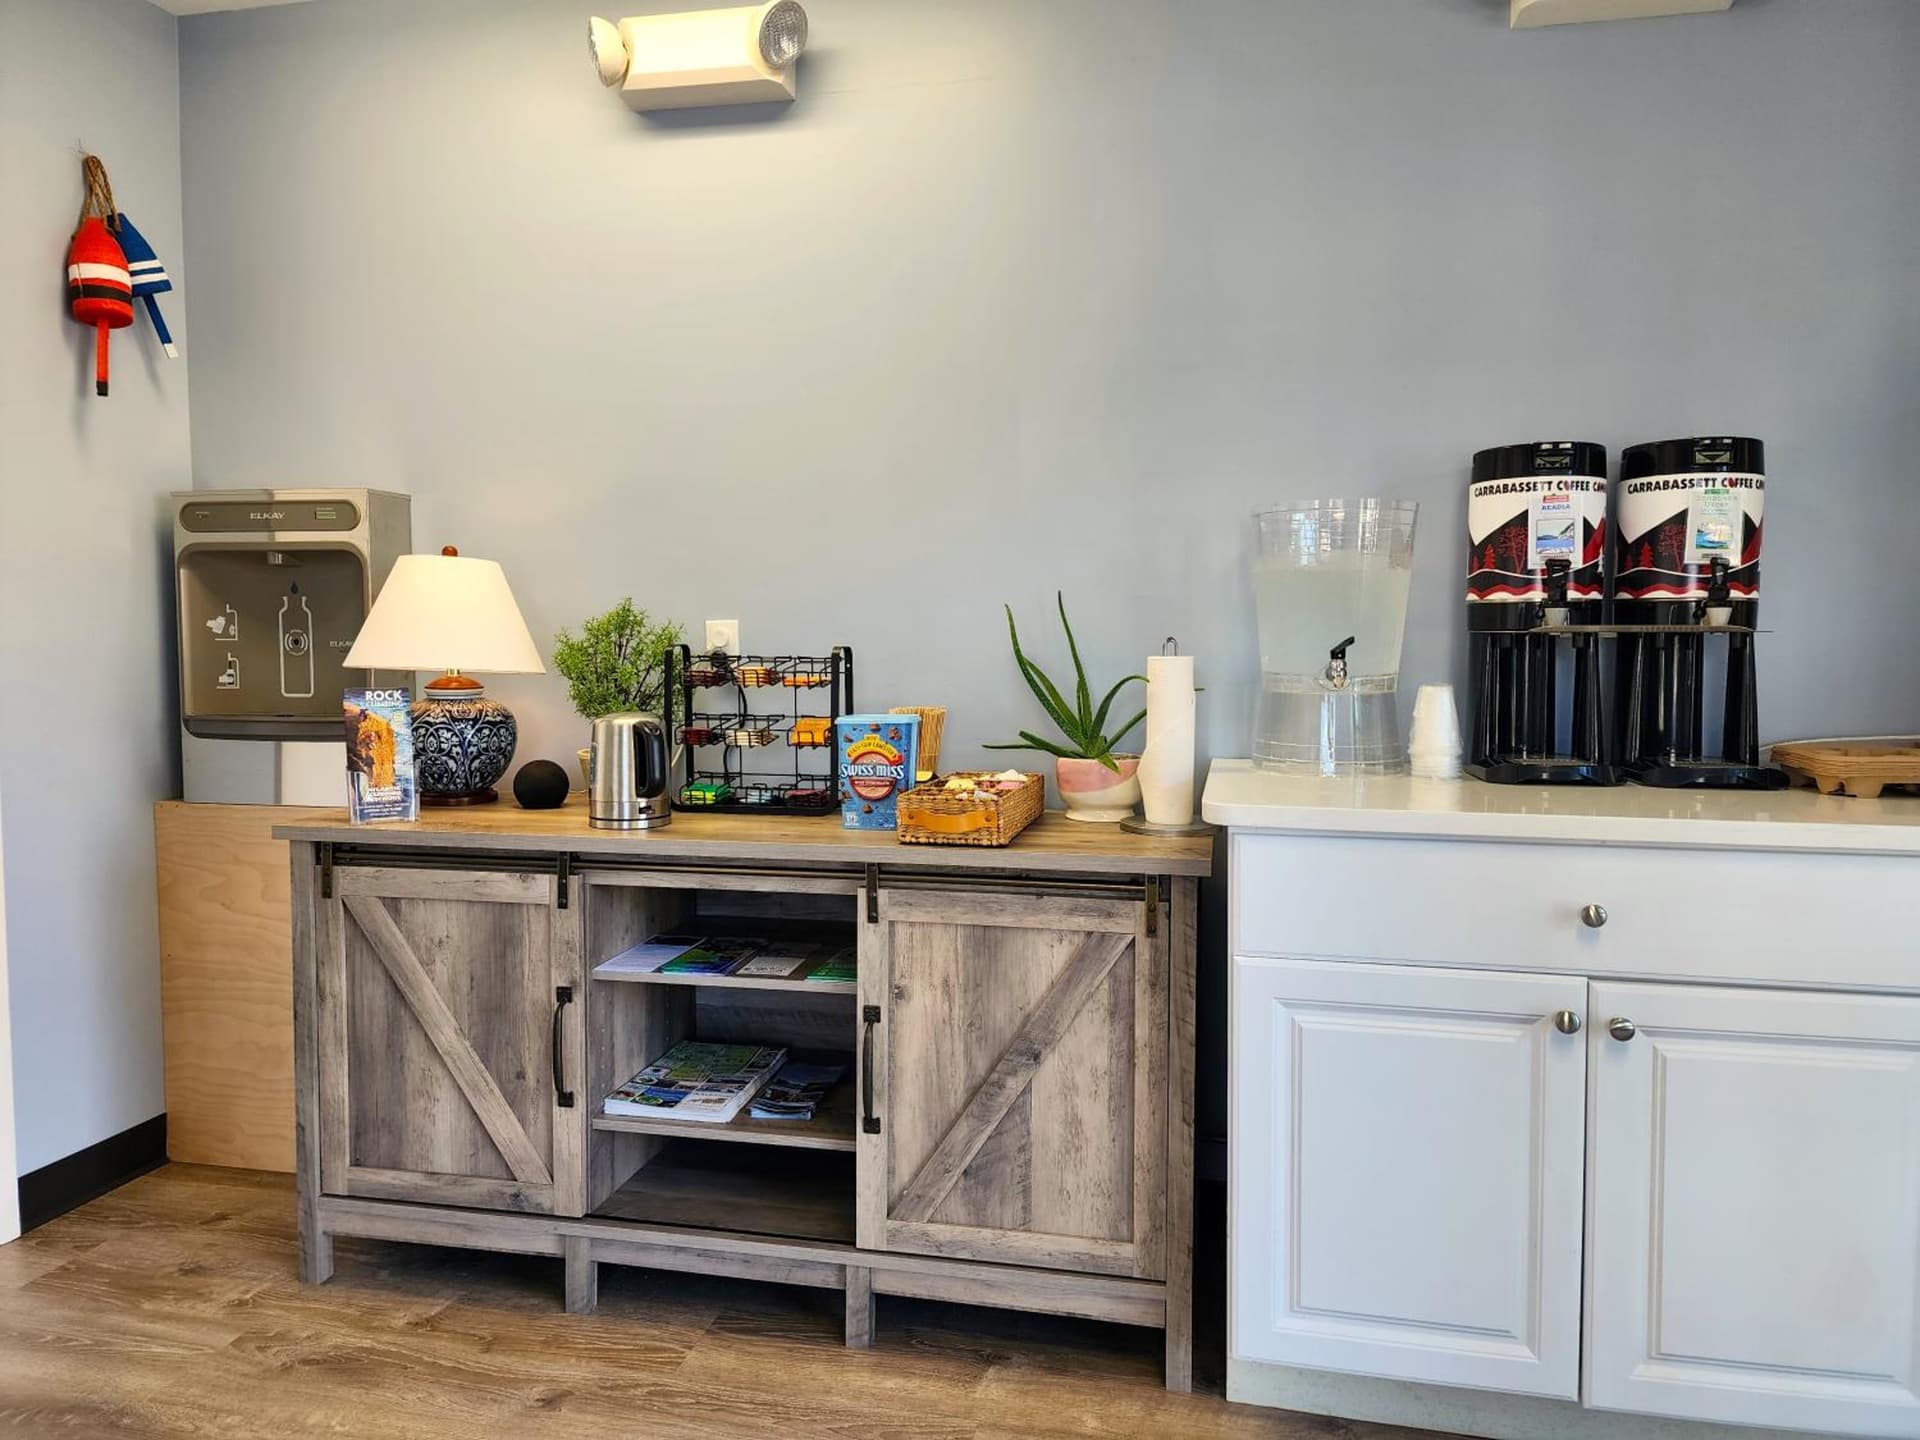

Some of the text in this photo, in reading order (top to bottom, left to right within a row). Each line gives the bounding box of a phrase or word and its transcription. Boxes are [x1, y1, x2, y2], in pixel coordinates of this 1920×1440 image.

[1474, 480, 1553, 497] CARRABASSETT
[1556, 480, 1590, 492] COFFEE
[1627, 477, 1718, 495] CARRABASSETT
[1721, 477, 1753, 489] COFFEE
[249, 512, 286, 520] ELKAY
[365, 689, 402, 701] ROCK
[840, 763, 874, 778] SWISS
